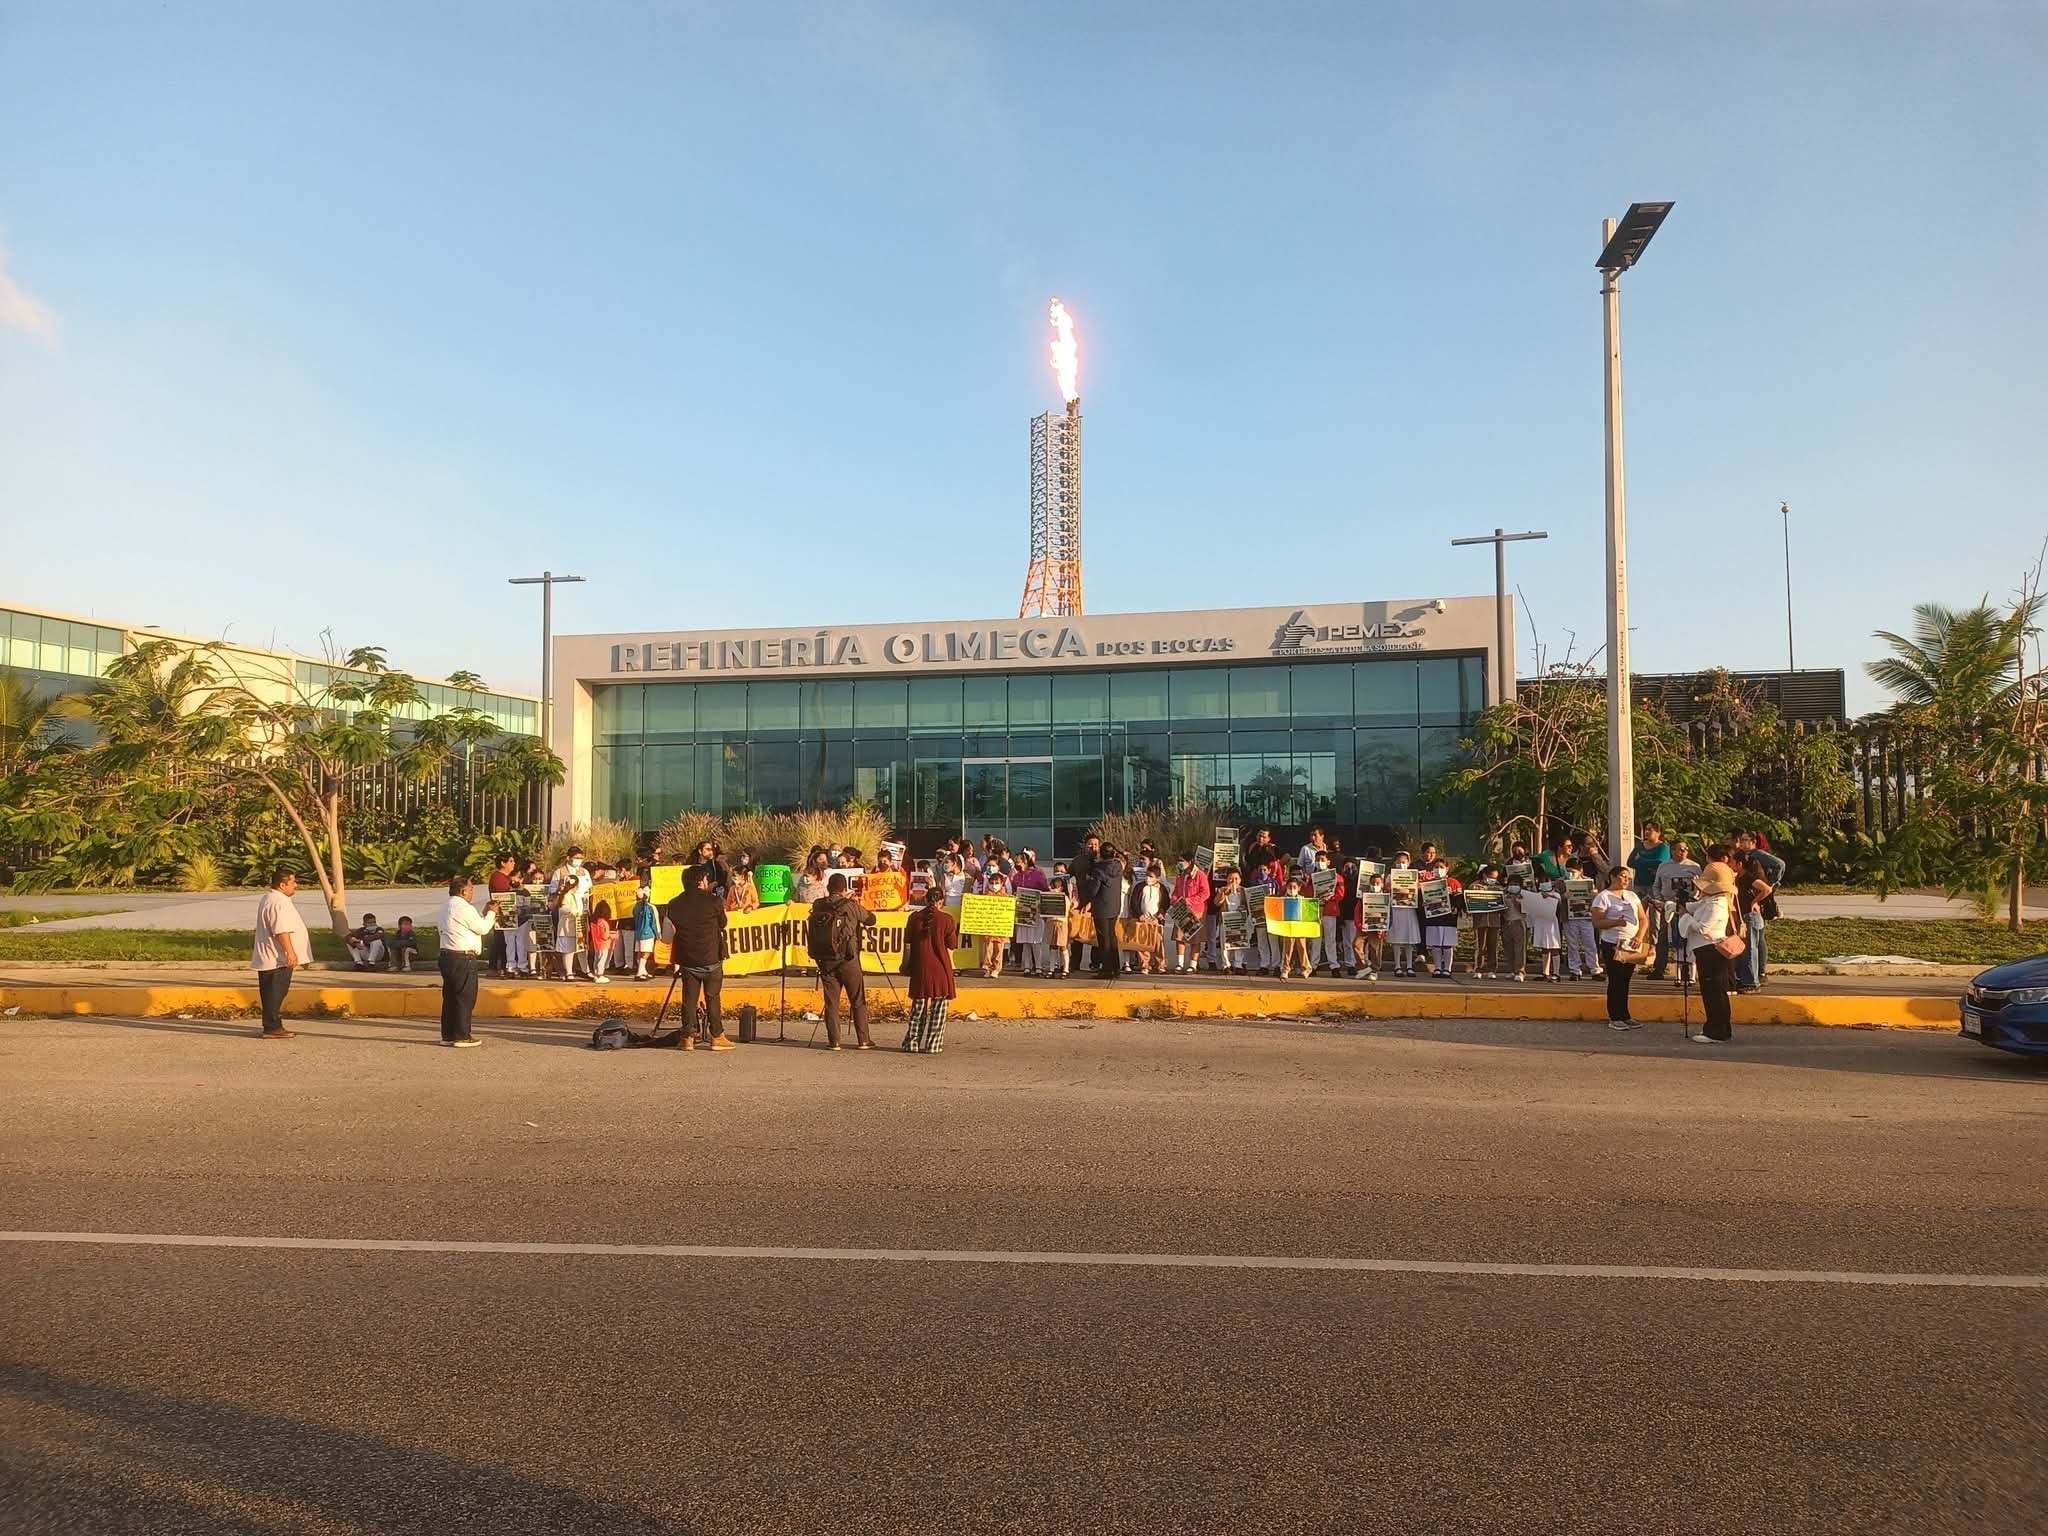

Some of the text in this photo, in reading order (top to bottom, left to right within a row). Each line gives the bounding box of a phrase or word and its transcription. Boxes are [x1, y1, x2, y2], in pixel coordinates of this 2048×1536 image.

[1319, 624, 1413, 641] PEMEX
[612, 627, 1234, 672] REFINERÍA OLMECA DOS BOCAS
[873, 899, 888, 908] NO
[859, 926, 903, 954] ESCU
